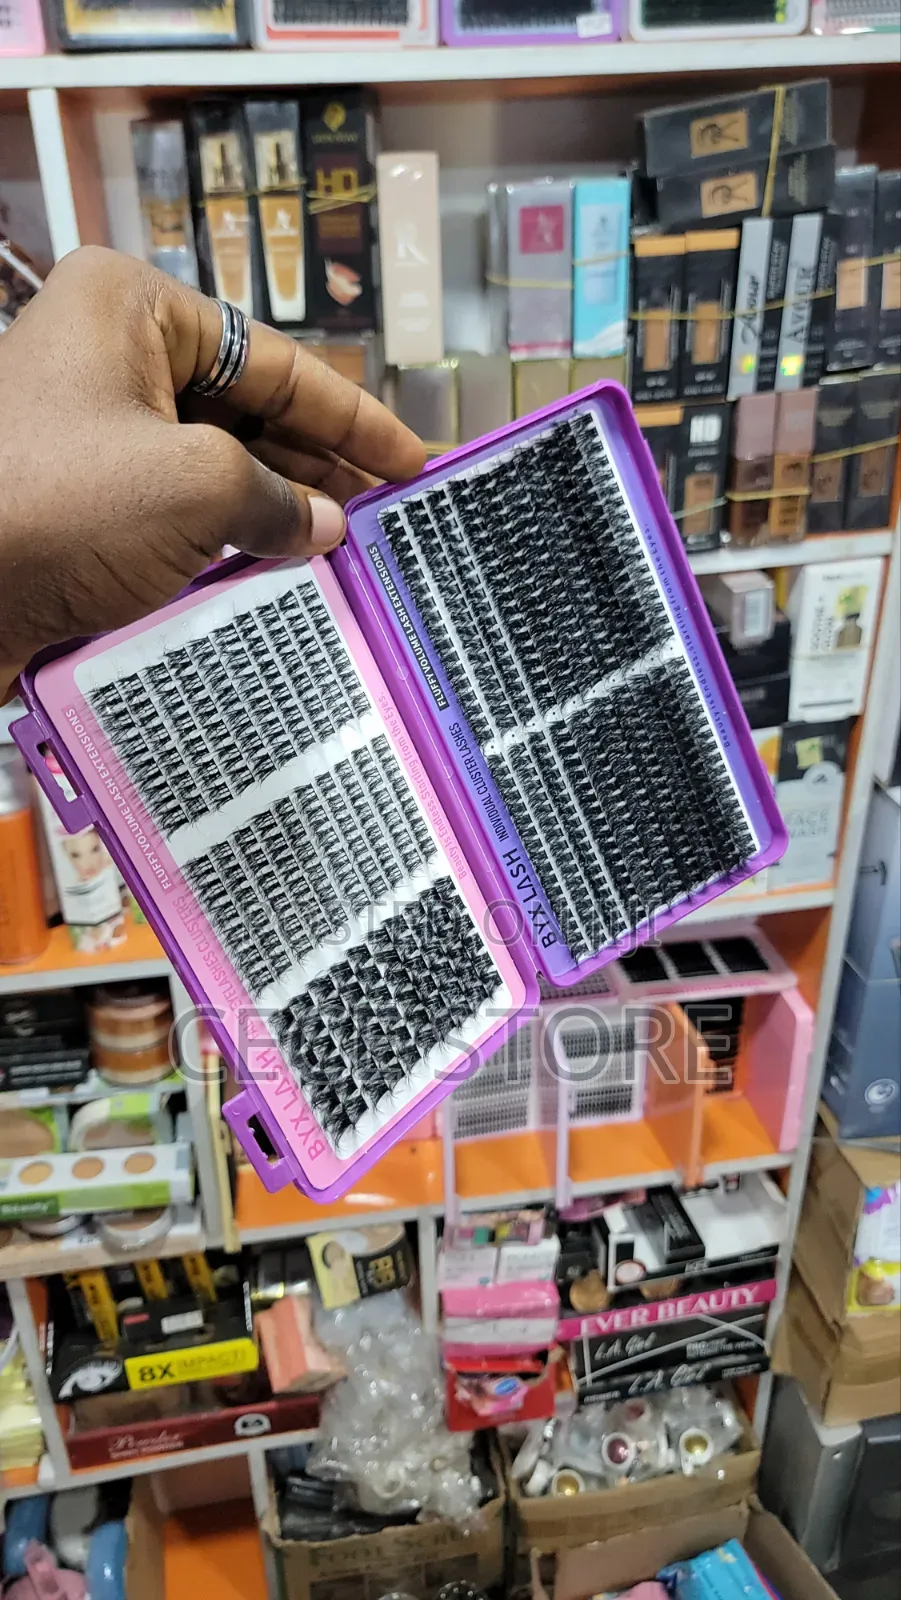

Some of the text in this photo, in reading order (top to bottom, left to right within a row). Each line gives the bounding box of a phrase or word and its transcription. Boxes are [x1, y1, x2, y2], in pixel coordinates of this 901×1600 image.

[653, 555, 665, 575] the
[660, 577, 676, 604] from
[368, 545, 446, 706] FLUFFY VOLUME LASH EXTENSIONS
[386, 718, 402, 737] the
[395, 736, 413, 760] from
[65, 707, 172, 890] FLUFFY VOLUME LASH EXTENSIONS
[447, 721, 509, 841] INDIVIDUAL CLUSTER LASHES
[446, 845, 469, 879] Beauty
[171, 895, 210, 952] CLUSTERS
[526, 902, 558, 948] BYX
[202, 949, 244, 1012] EYELASHES
[287, 1107, 327, 1161] BYX
[581, 1285, 760, 1335] EVER BEAUTY
[138, 1361, 175, 1382] 8X
